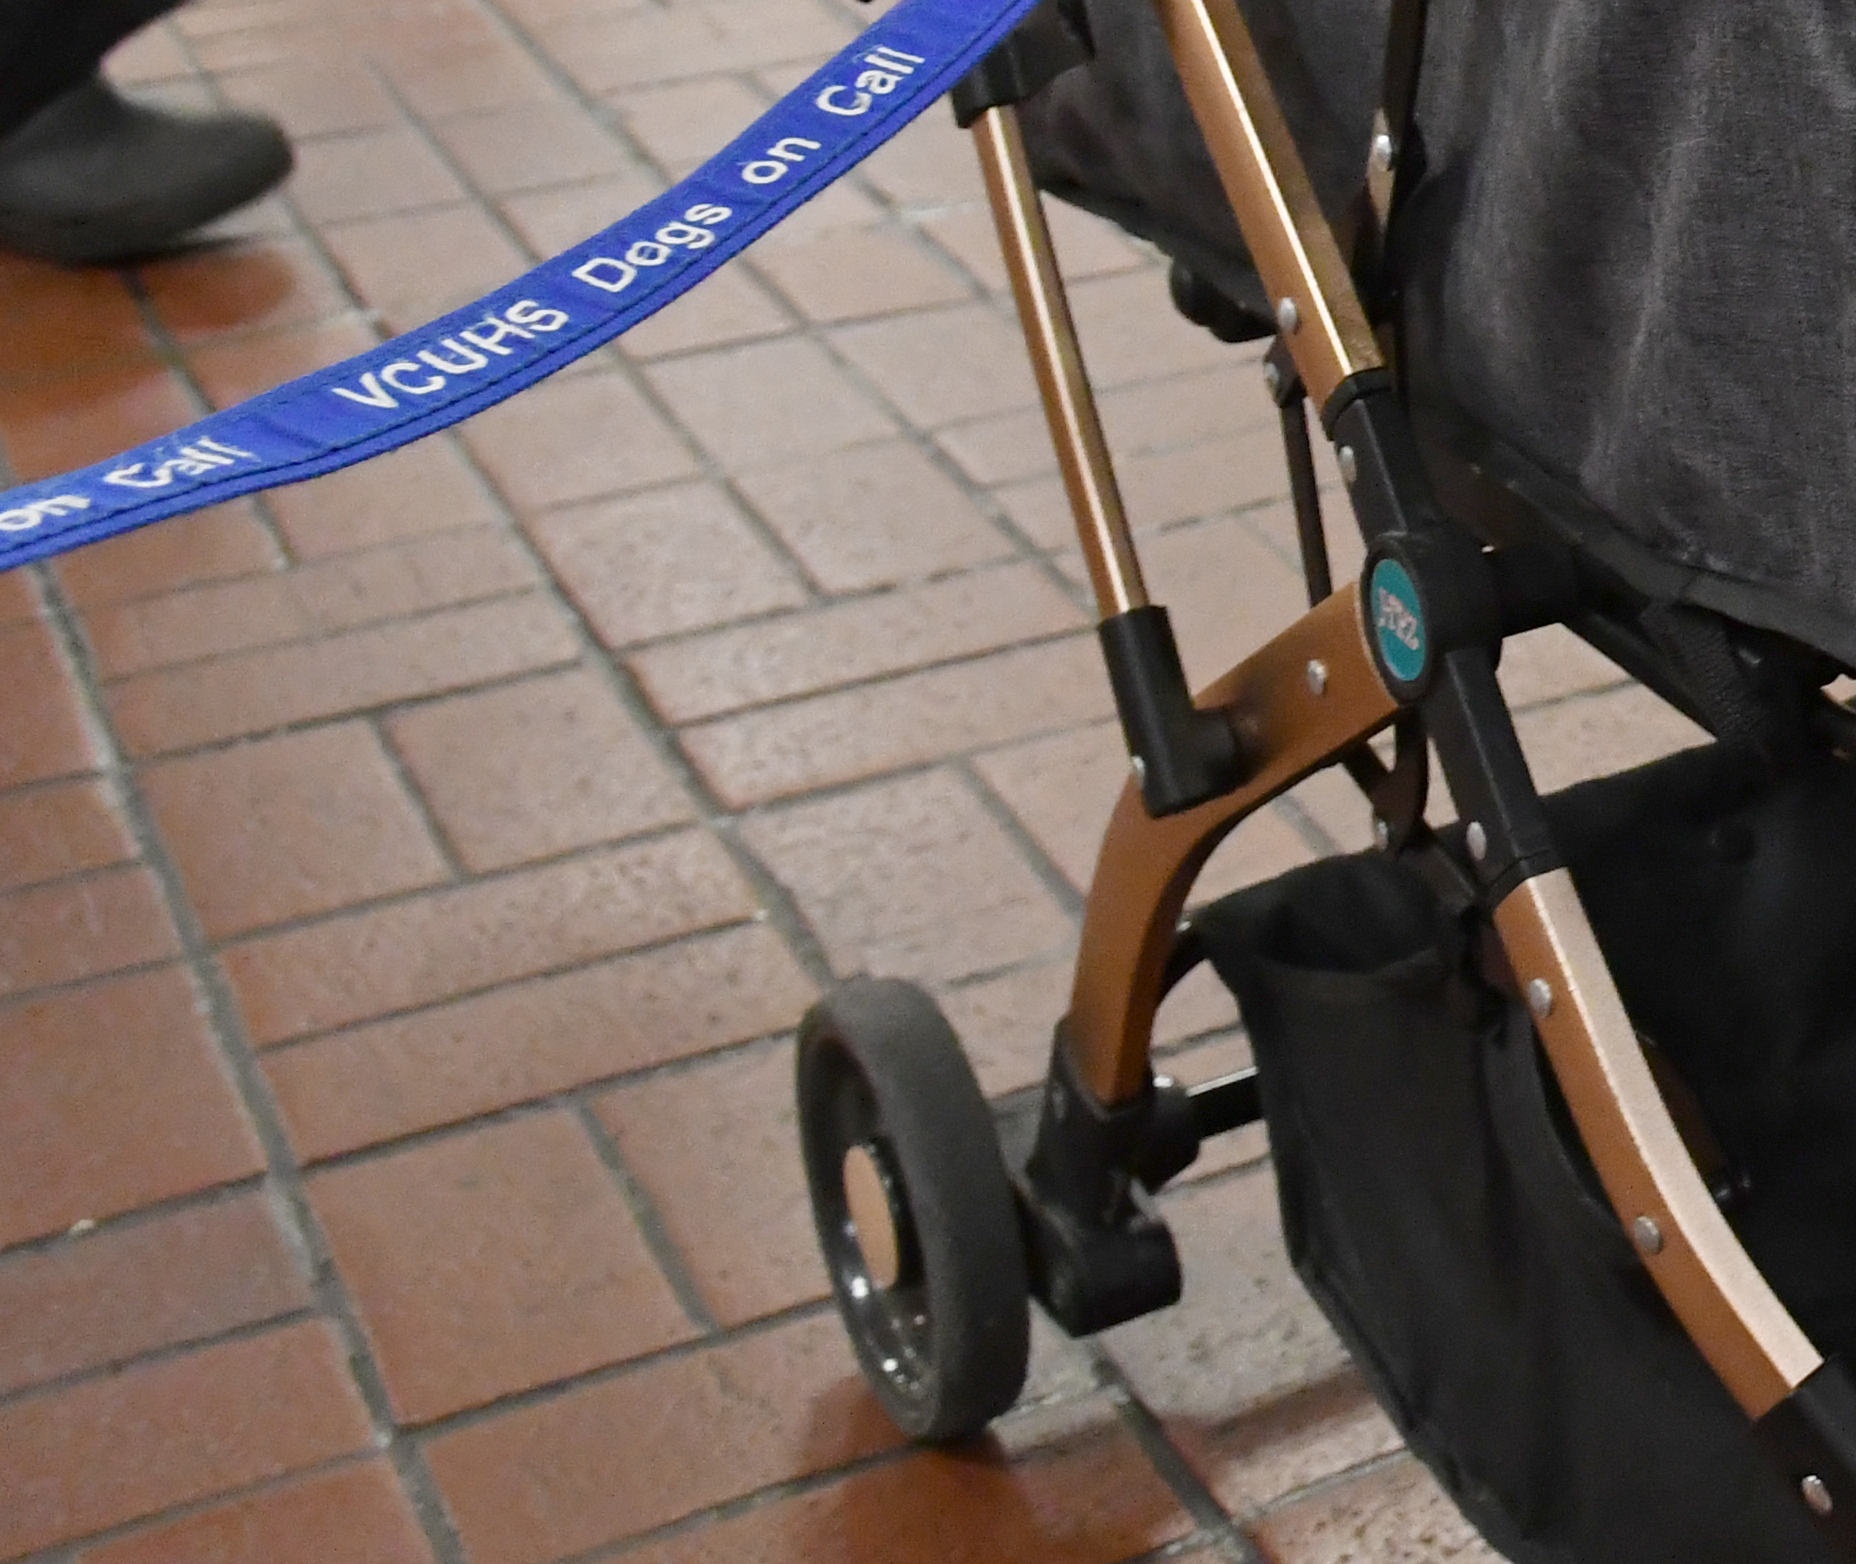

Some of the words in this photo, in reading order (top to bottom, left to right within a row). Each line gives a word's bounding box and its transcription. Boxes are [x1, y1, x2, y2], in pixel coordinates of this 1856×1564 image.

[103, 437, 258, 488] Call
[331, 300, 569, 409] VCUHS
[572, 203, 732, 292] Dogs
[741, 136, 821, 185] on
[815, 46, 925, 116] Call
